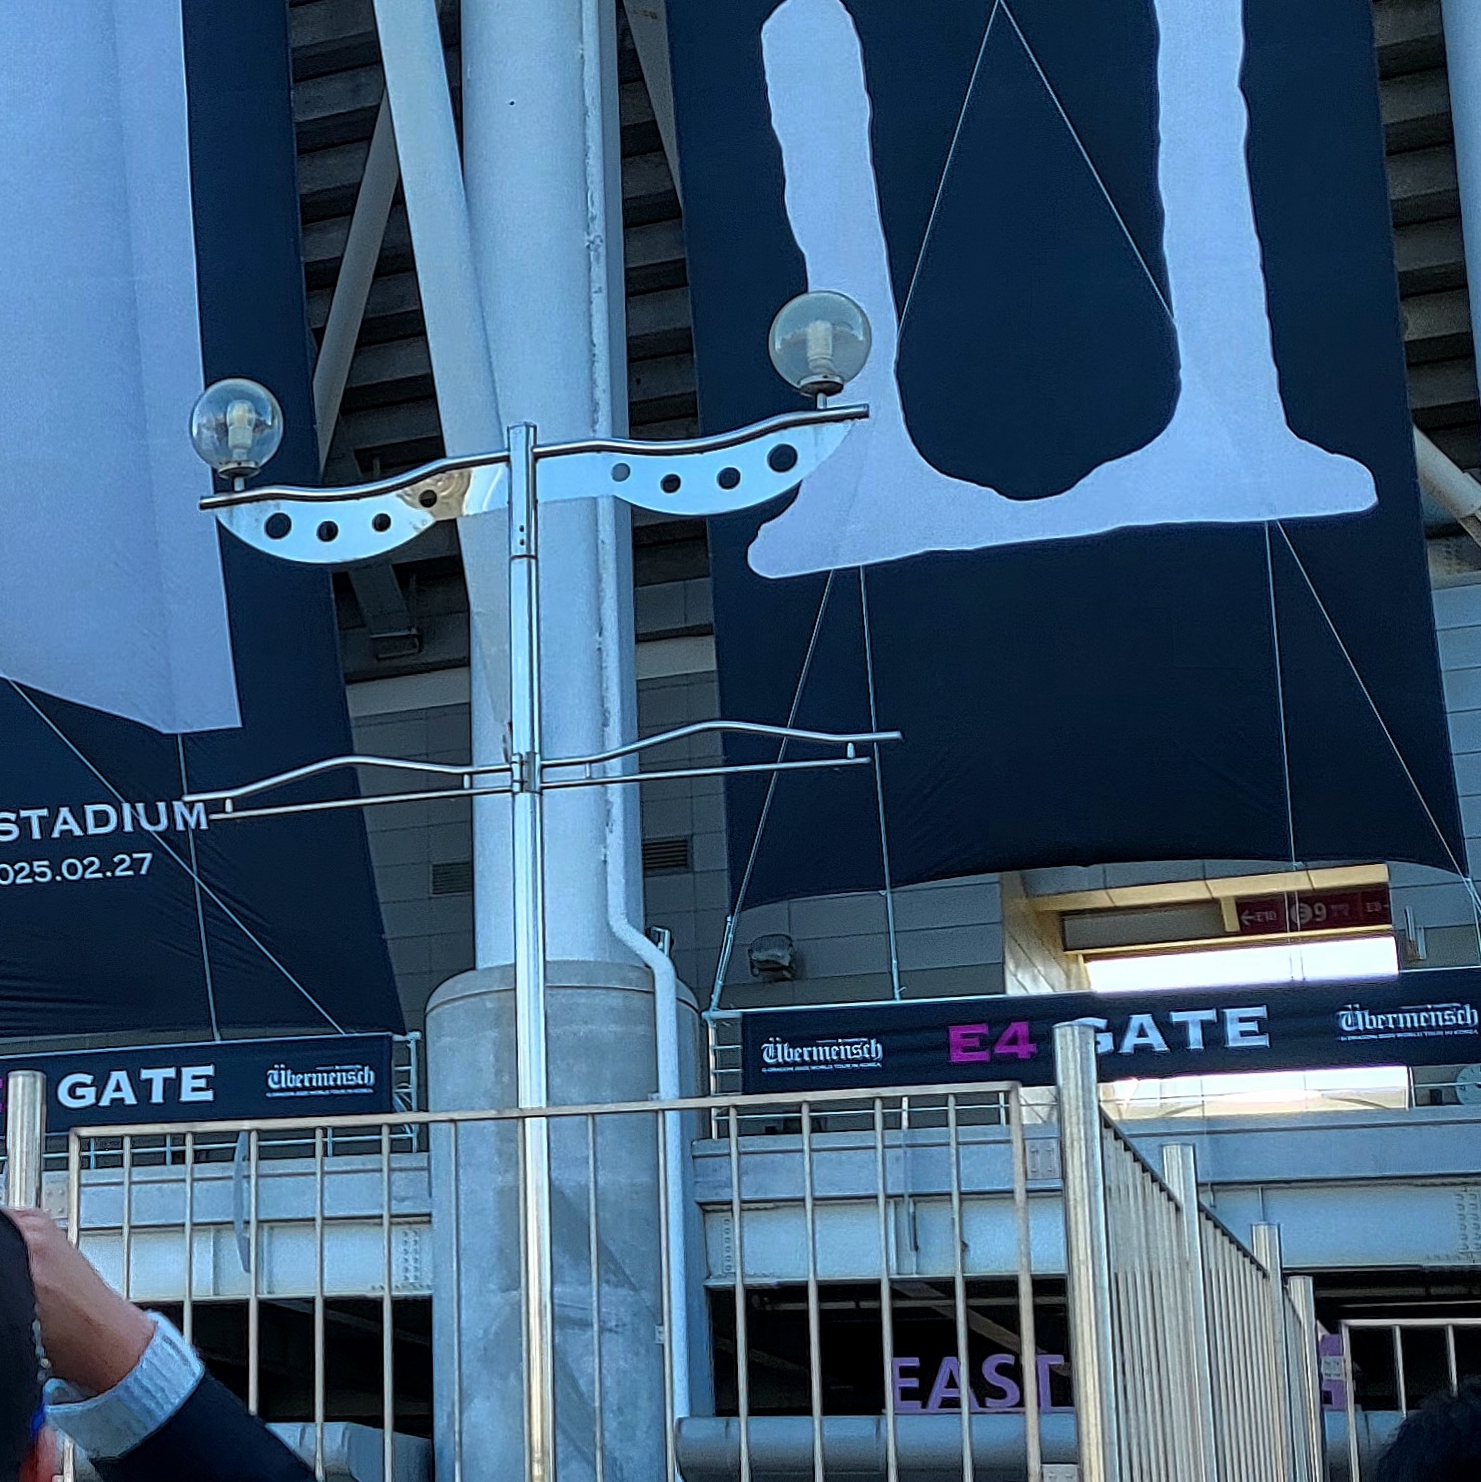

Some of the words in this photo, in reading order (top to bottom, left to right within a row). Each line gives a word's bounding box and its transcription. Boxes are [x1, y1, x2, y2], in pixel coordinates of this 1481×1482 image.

[761, 1036, 884, 1064] Übermensch
[948, 1021, 1037, 1063] E4
[56, 1064, 215, 1109] GATE
[266, 1063, 376, 1090] Übermensch
[892, 1352, 1067, 1413] EAST
